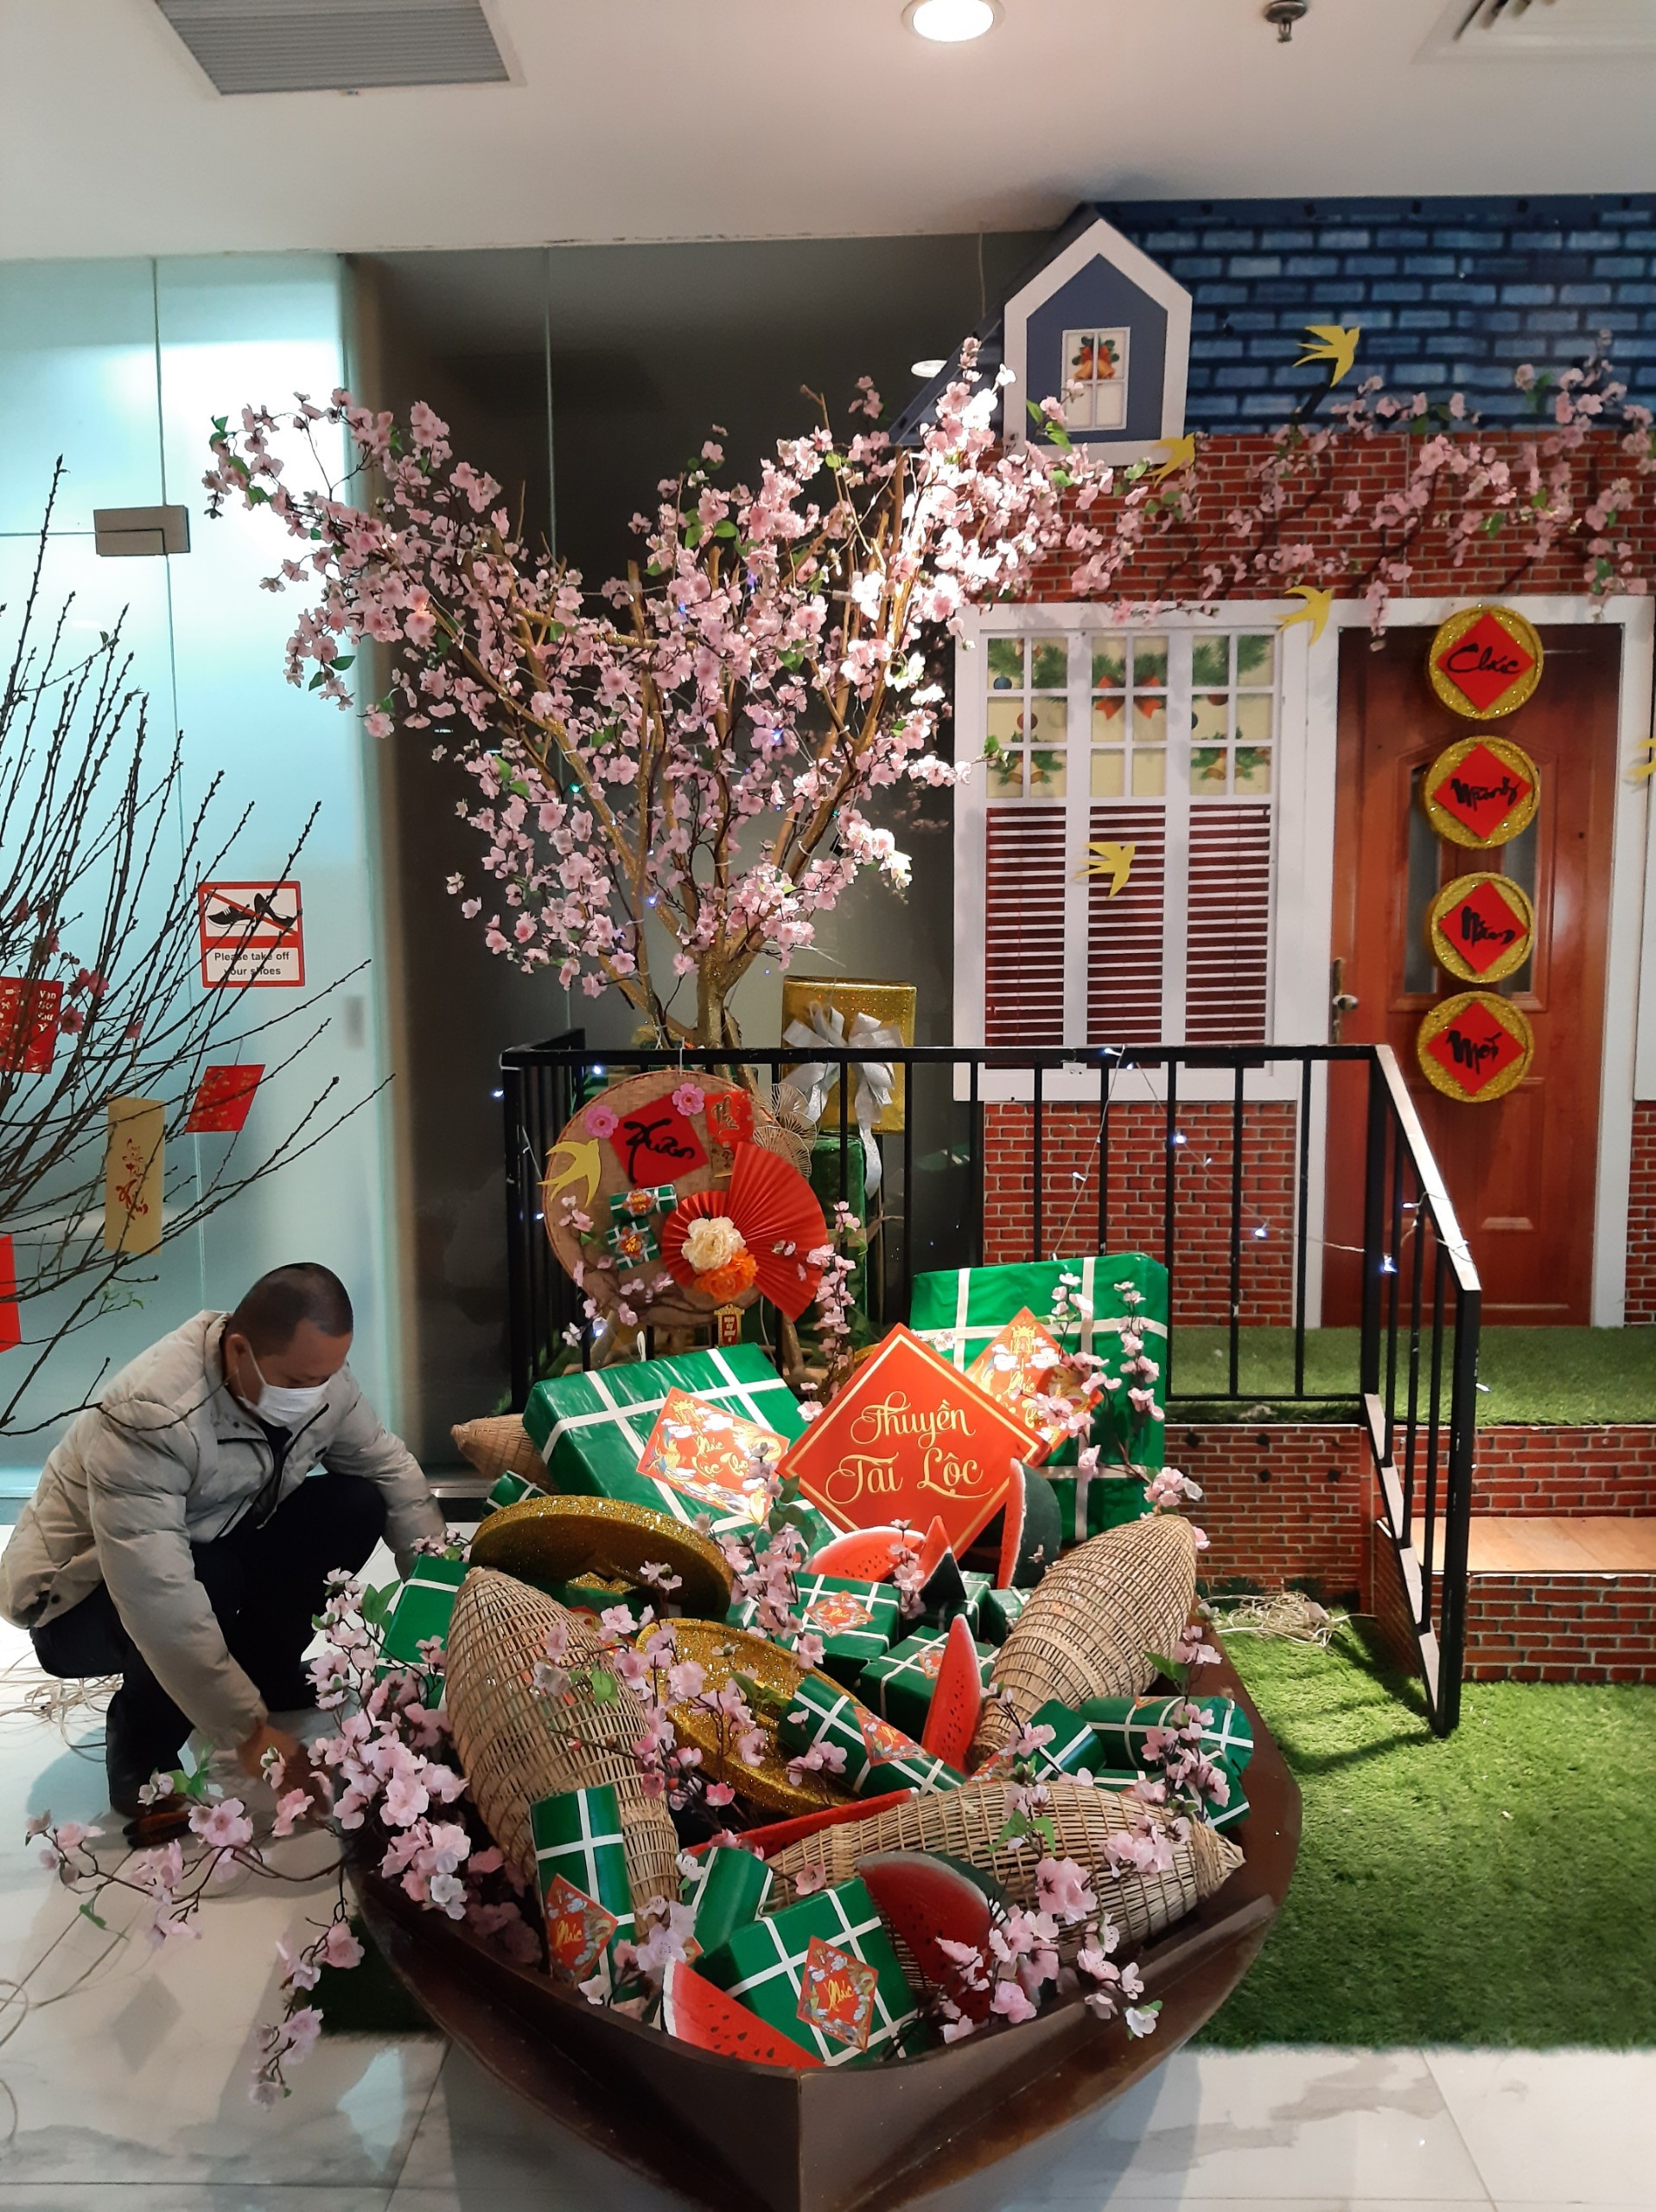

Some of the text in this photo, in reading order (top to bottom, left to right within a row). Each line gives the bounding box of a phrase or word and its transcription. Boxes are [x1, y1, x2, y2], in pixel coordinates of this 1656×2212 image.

[251, 950, 273, 961] take
[276, 950, 290, 961] off
[850, 1390, 977, 1449] Thuyền
[825, 1447, 994, 1504] Tài Lộc
